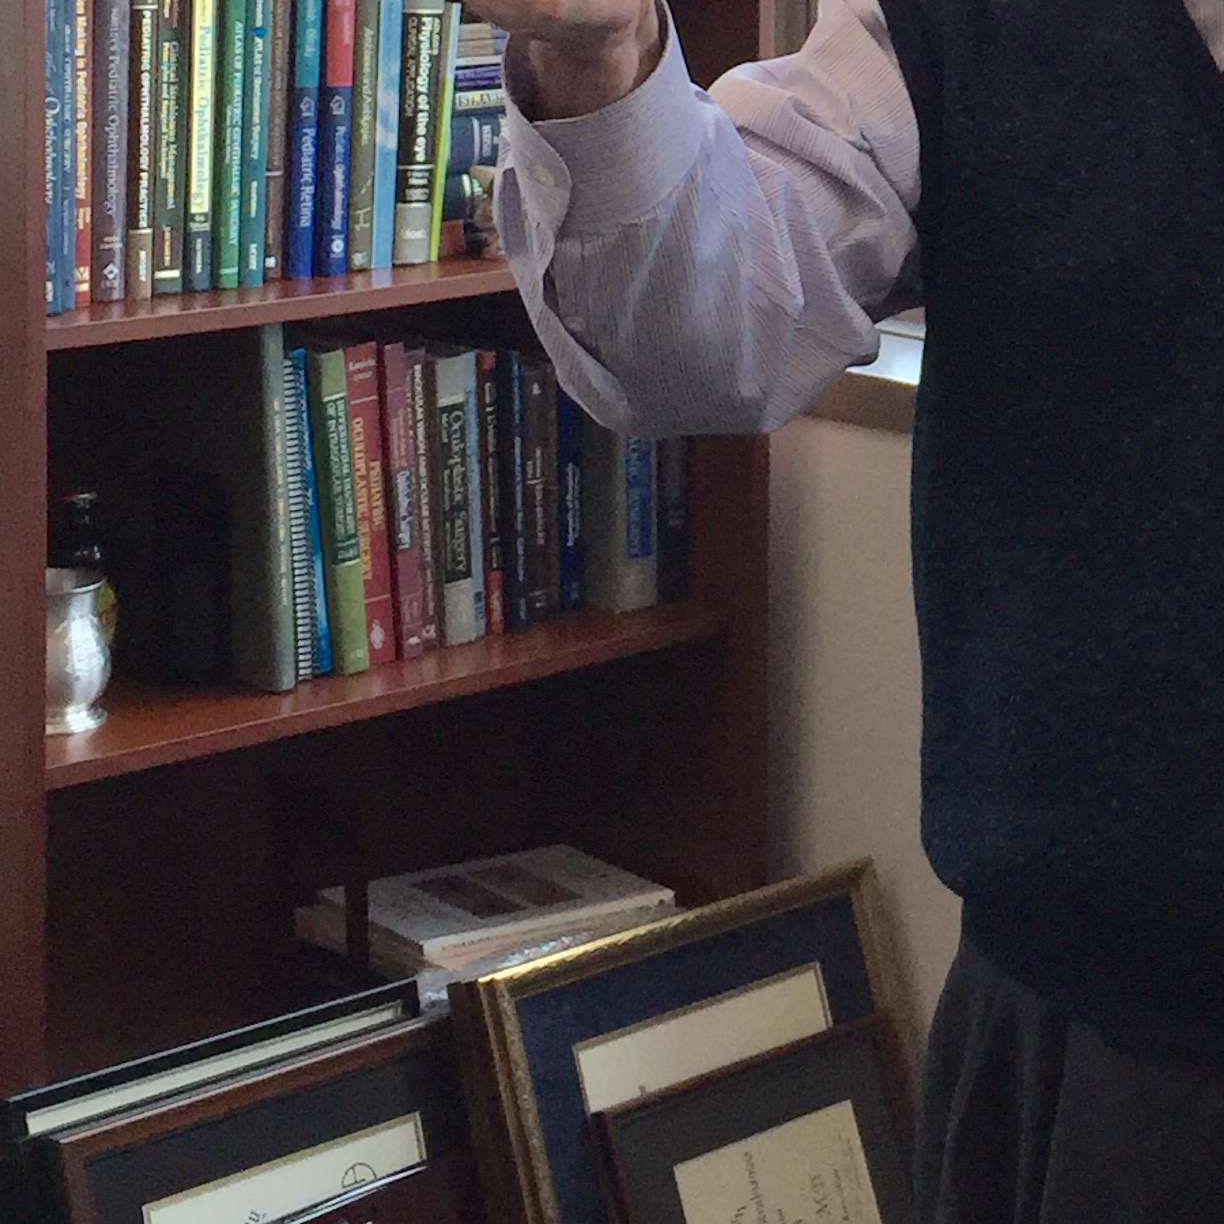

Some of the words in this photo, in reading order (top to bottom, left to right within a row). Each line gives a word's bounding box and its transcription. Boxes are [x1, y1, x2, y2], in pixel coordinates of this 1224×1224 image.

[75, 15, 88, 56] Making
[141, 9, 153, 71] PEDIATRIC
[198, 24, 213, 91] Pediatric
[233, 21, 244, 54] ATLAS
[233, 55, 244, 70] OF
[415, 16, 434, 93] Physiology
[107, 55, 121, 113] Pediatric
[416, 93, 431, 112] of
[139, 71, 152, 171] OPHTHALMOLOGY
[413, 135, 428, 164] eye
[415, 111, 430, 136] the
[103, 115, 121, 217] Ophthalmology
[193, 95, 210, 208] Ophthalmology
[300, 127, 317, 185] Pediatric
[138, 171, 150, 228] PRACTICE
[299, 185, 316, 229] Retina
[351, 416, 370, 519] OCULOPLASTIC
[369, 460, 386, 530] PEDIATRIC
[451, 510, 468, 572] Surgery
